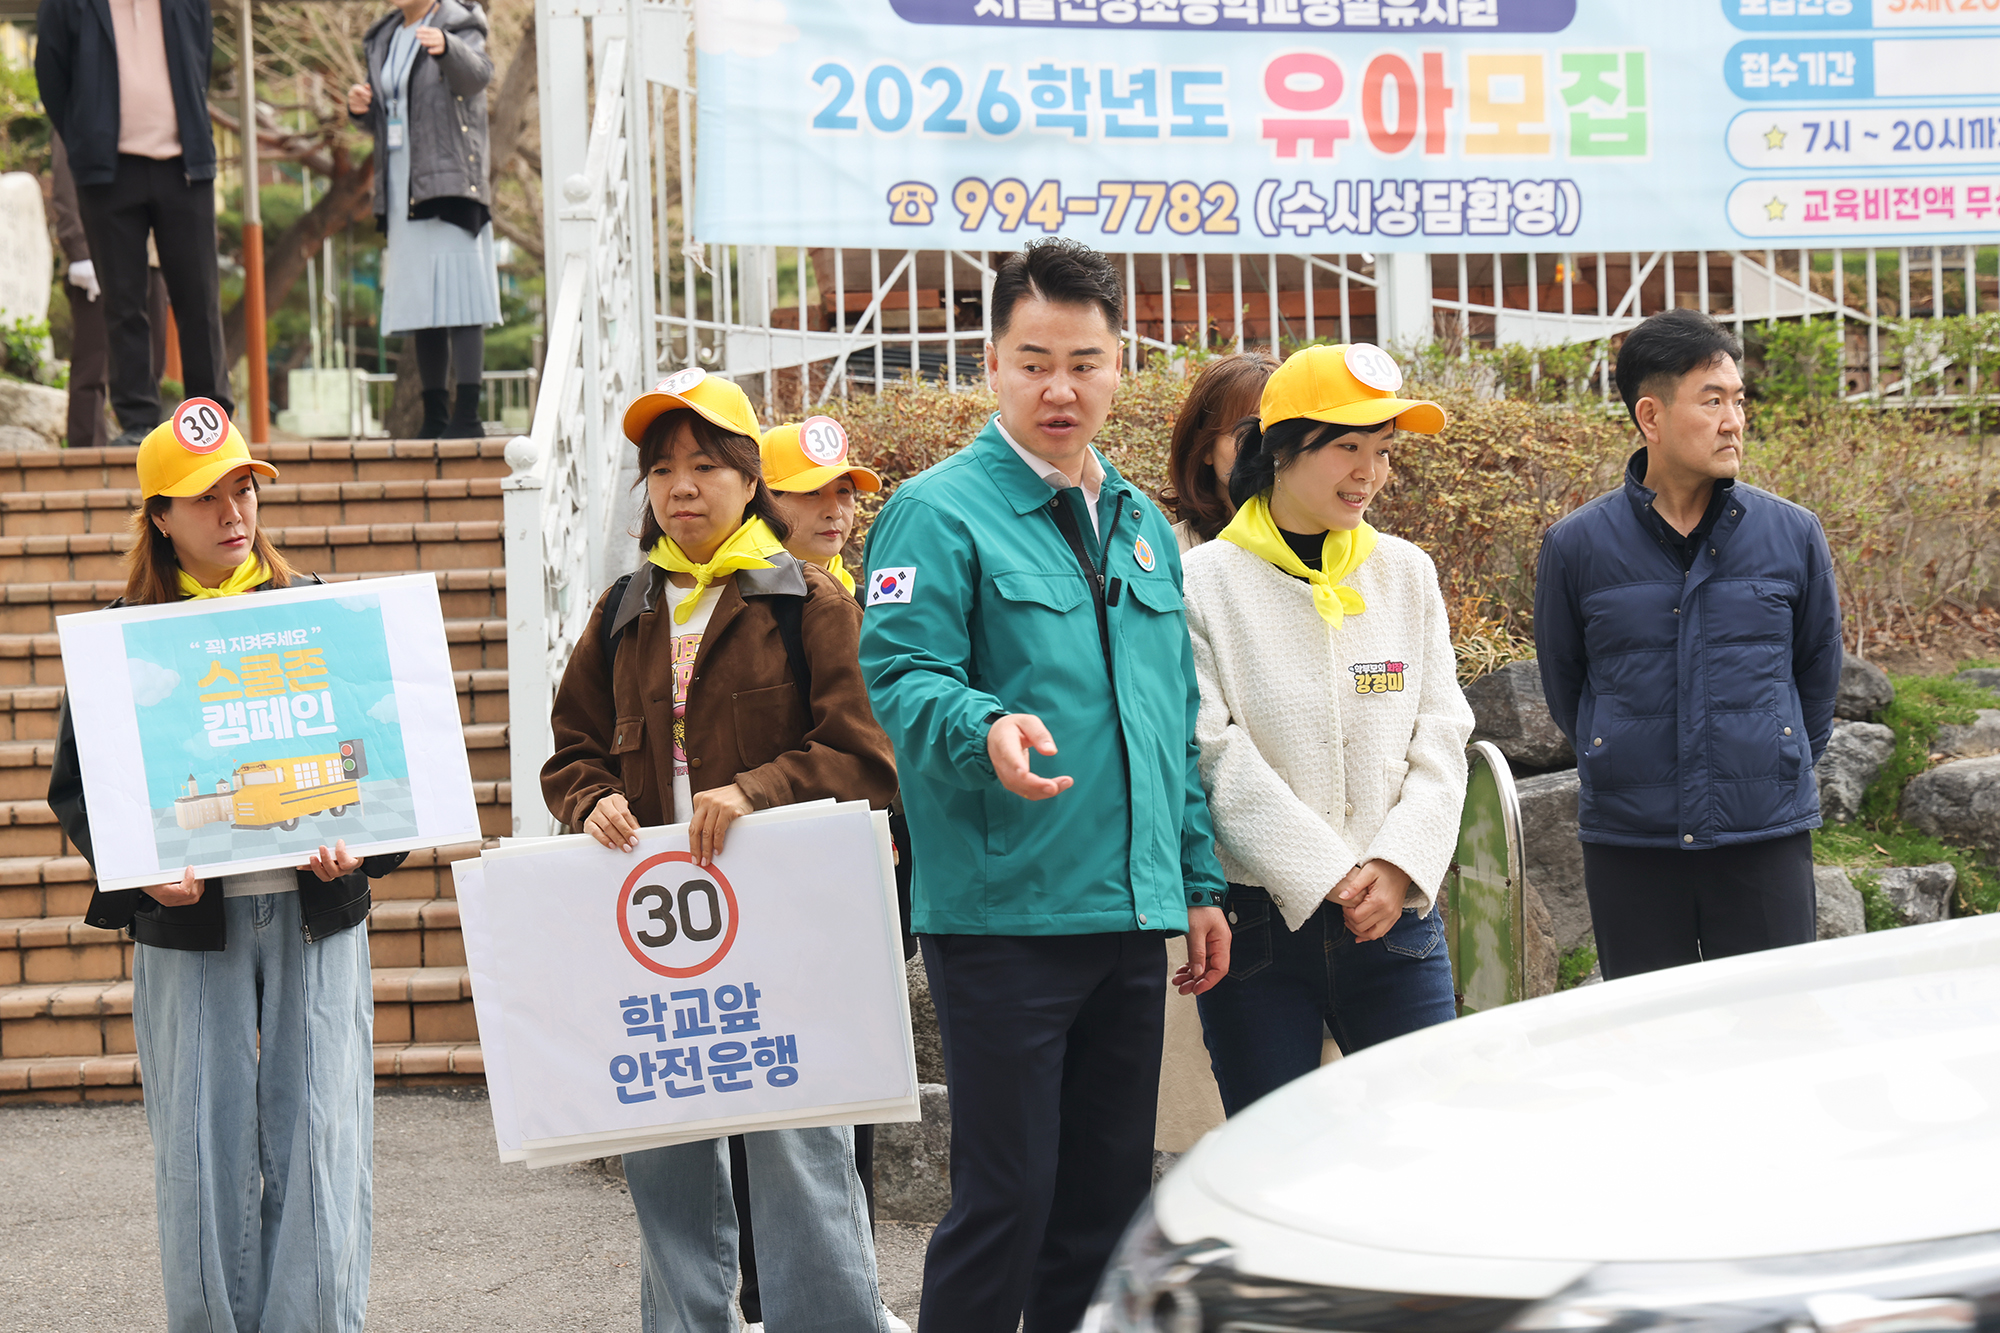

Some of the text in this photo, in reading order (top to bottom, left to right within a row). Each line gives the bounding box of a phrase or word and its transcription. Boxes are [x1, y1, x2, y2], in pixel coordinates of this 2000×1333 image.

[1740, 51, 1856, 88] 접수기간
[810, 51, 1648, 158] 2026학년도 유아모집
[1802, 120, 1850, 153] 7시
[1892, 116, 2000, 151] 20시까
[952, 177, 1240, 236] 994-7782
[1254, 178, 1582, 237] (수시상담환영)
[1803, 185, 2000, 222] 교육비전액 무
[664, 372, 695, 393] 30
[1356, 354, 1393, 377] 30
[182, 406, 219, 441] 30
[201, 431, 219, 445] km/h
[809, 425, 839, 453] 30
[204, 638, 227, 654] 꼭!
[228, 629, 309, 652] 지켜주세요
[197, 647, 329, 703] 스쿨존
[1354, 672, 1404, 694] 강경미
[202, 690, 338, 747] 캠페인
[632, 879, 722, 948] 30
[619, 982, 761, 1042] 학교앞
[609, 1034, 799, 1105] 안전운행
